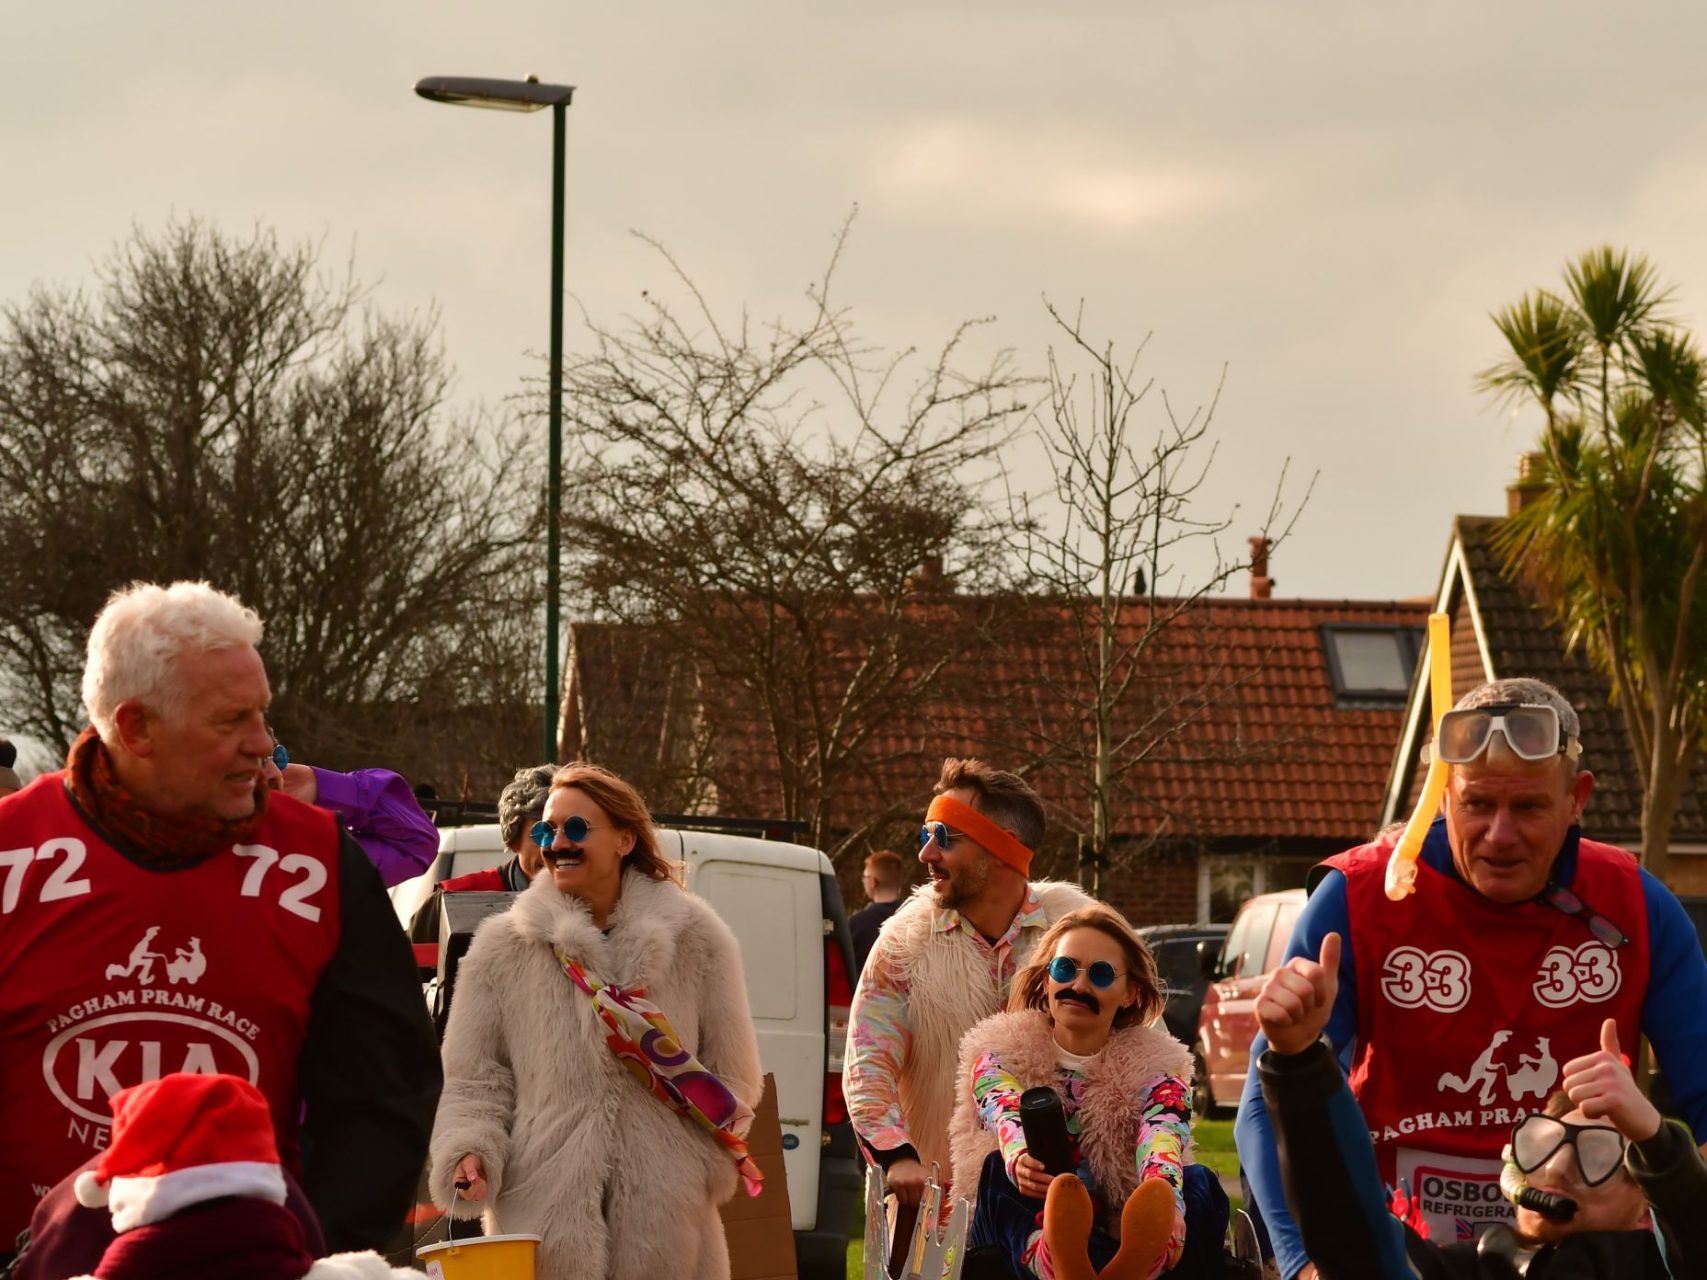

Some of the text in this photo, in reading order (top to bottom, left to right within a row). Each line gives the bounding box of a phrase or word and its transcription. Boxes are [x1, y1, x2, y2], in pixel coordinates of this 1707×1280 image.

[0, 837, 91, 914] 72
[232, 843, 328, 923] 72
[1381, 945, 1472, 1014] 33
[1533, 940, 1622, 1009] 33
[47, 989, 261, 1041] PAGHAM PRAM RACE
[67, 1118, 112, 1151] NE
[1480, 1107, 1540, 1127] PRA
[1423, 1177, 1510, 1203] OSBO
[1423, 1199, 1517, 1219] REFRIGERA
